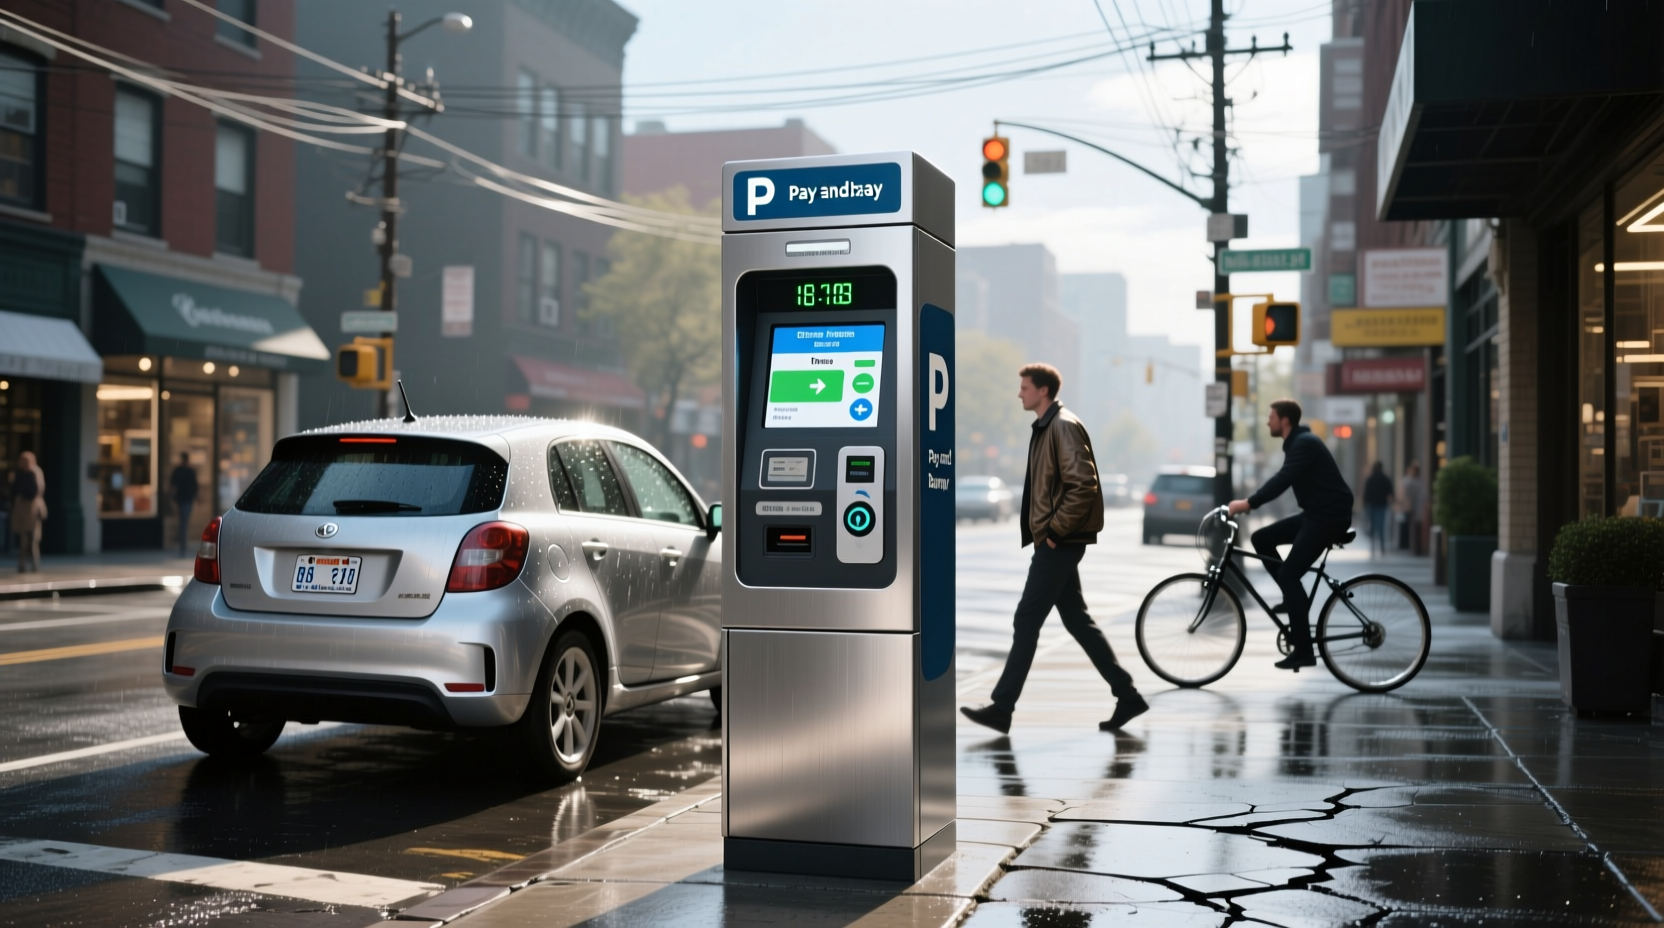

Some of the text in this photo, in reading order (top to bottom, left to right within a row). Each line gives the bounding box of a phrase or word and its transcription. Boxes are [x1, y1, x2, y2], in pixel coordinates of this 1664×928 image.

[747, 176, 775, 216] P
[789, 184, 818, 205] Pay
[928, 352, 949, 432] P
